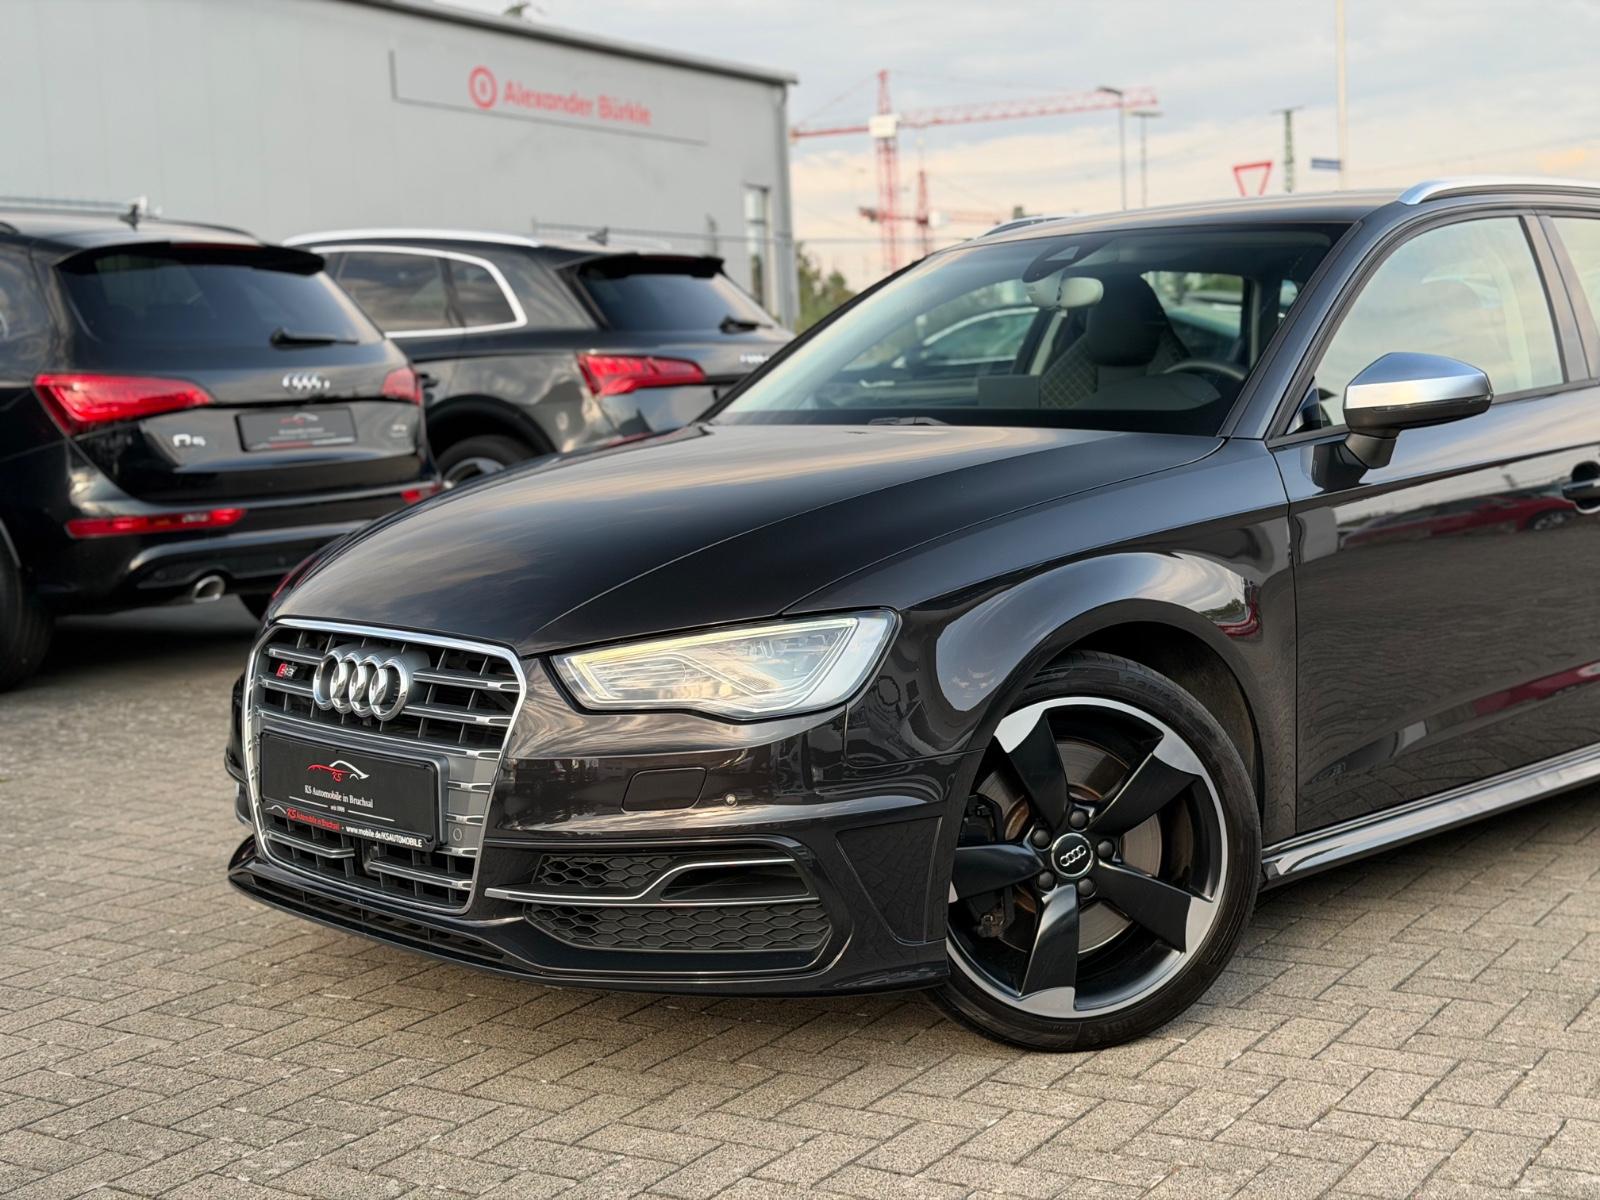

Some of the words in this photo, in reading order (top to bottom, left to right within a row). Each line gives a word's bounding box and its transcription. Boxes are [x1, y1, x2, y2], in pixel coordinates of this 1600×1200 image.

[504, 80, 593, 116] Alexander
[304, 785, 312, 794] KS
[312, 787, 342, 801] Automobile
[349, 795, 374, 809] Bruchsal
